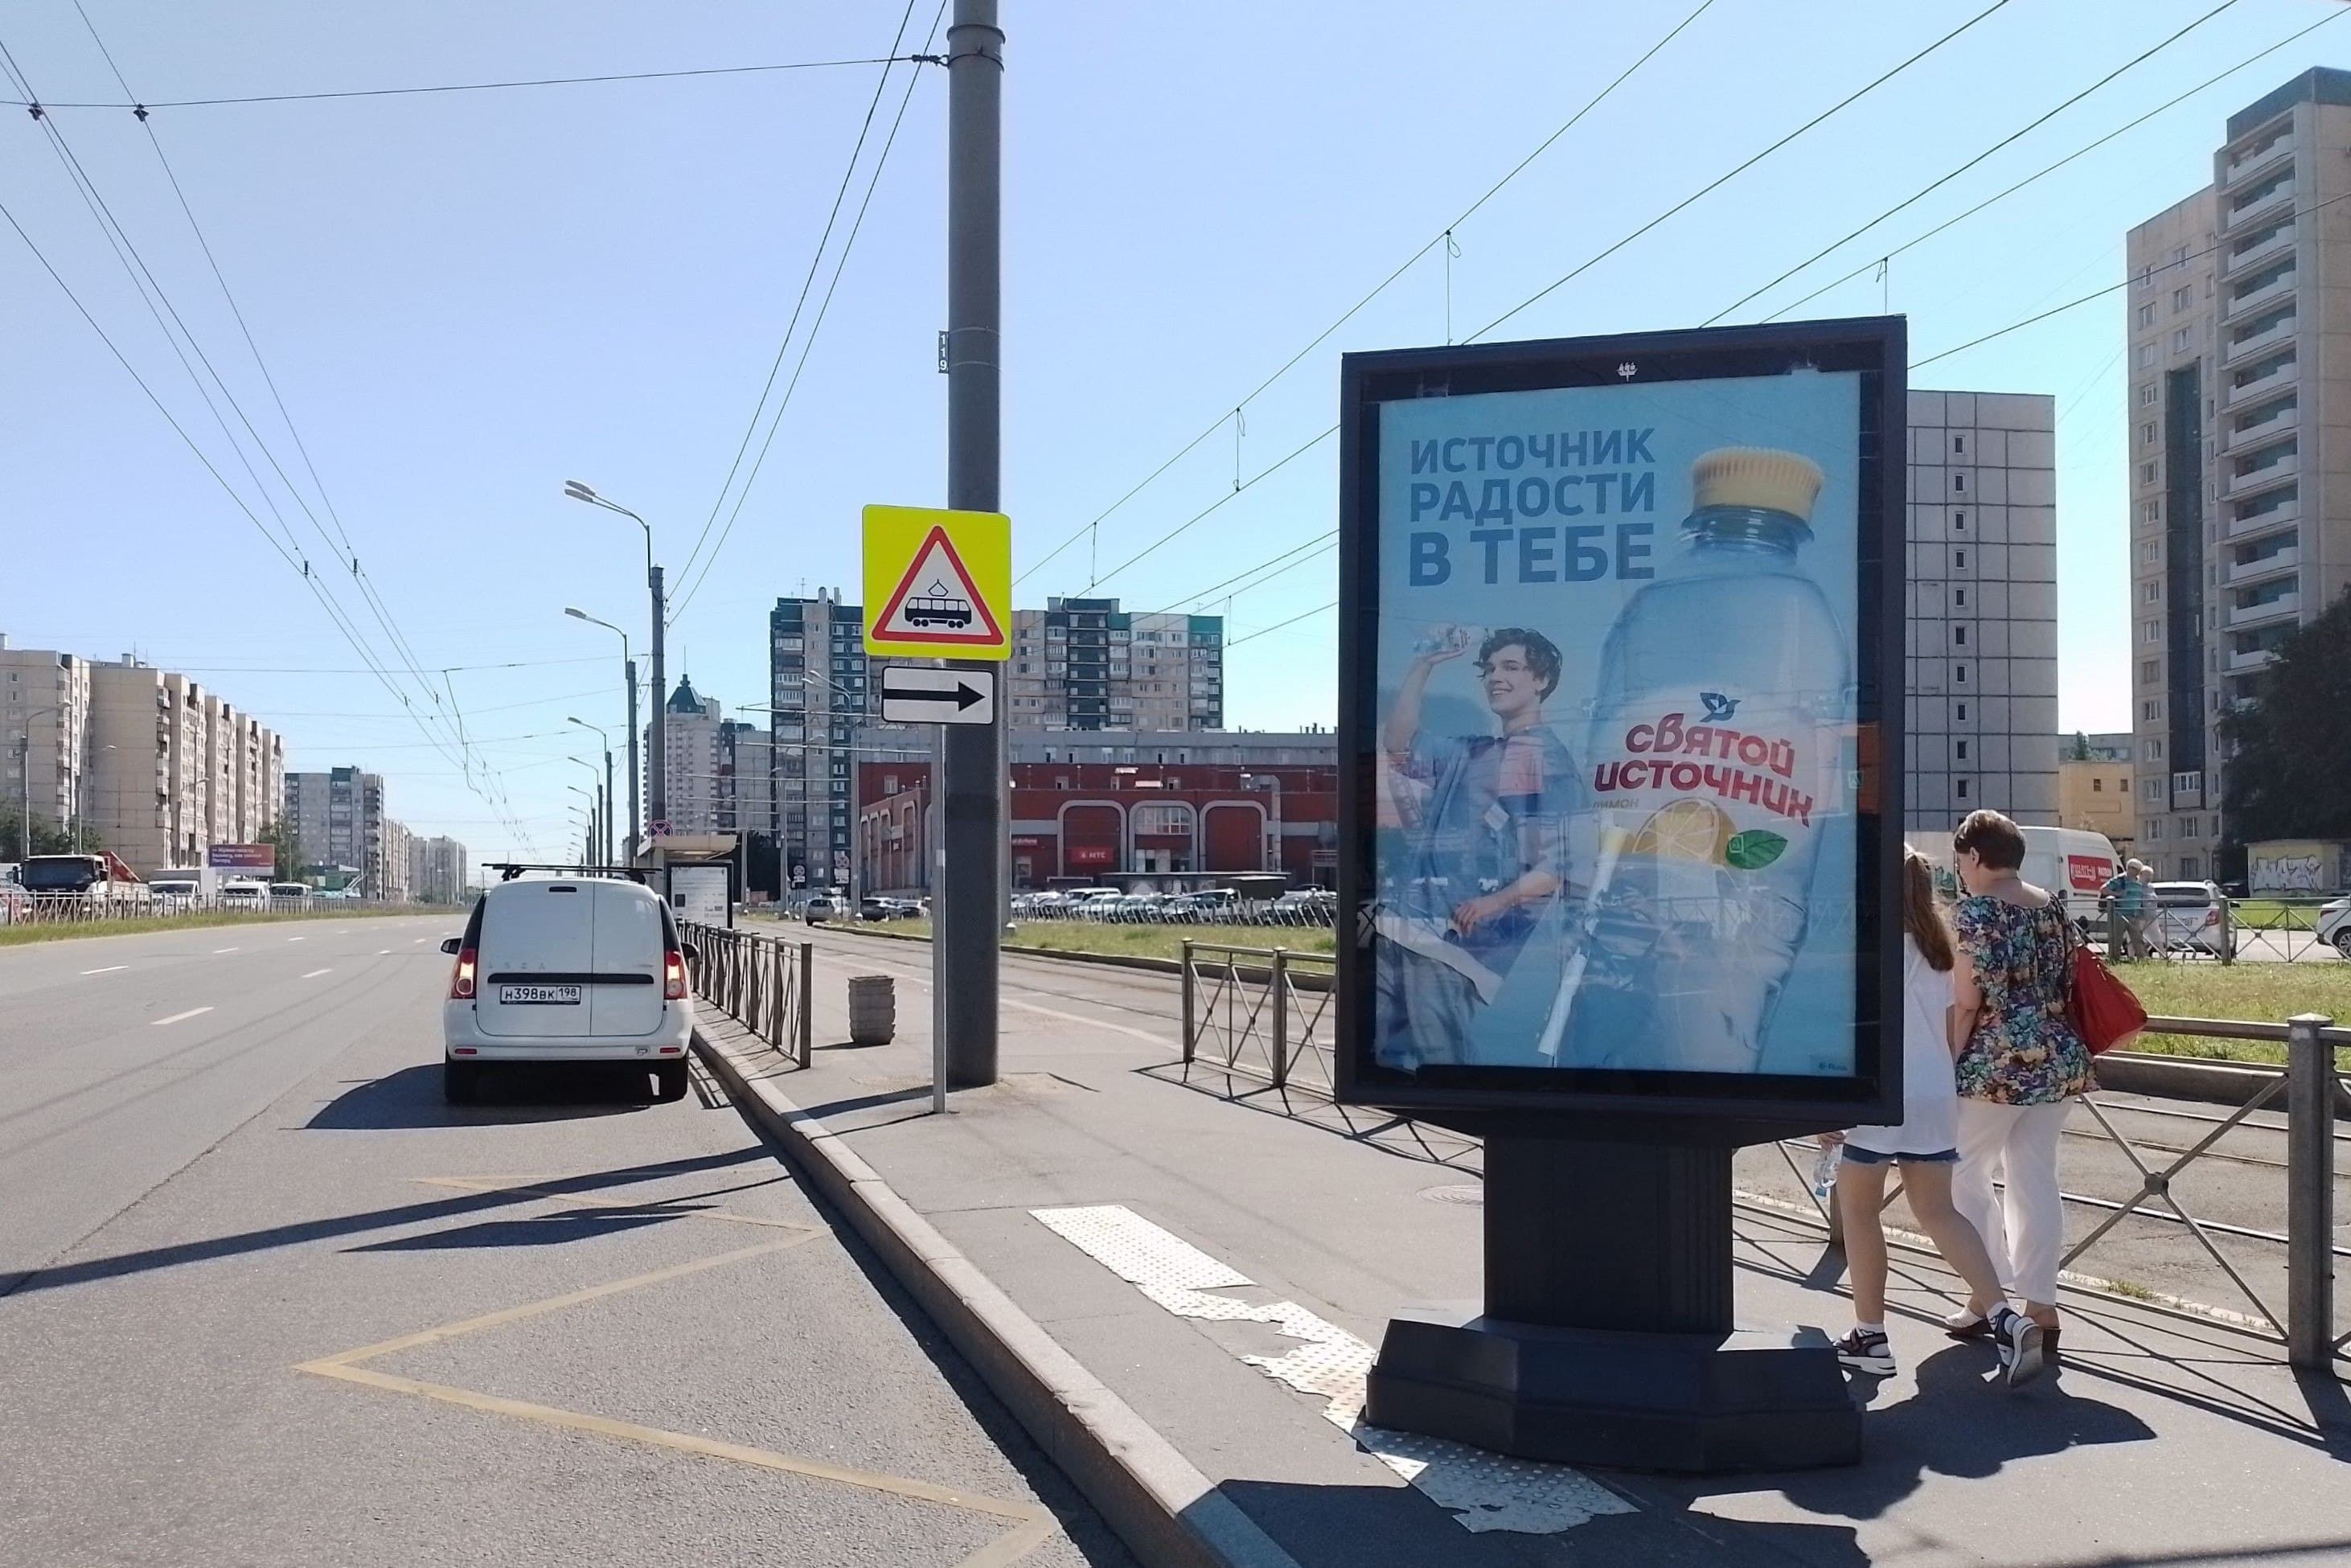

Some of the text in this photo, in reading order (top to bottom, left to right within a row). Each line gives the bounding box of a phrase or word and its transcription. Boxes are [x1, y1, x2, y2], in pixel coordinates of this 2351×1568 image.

[1411, 428, 1656, 475] ИСТОЧНИК
[1410, 471, 1655, 527] РАДОСТИ
[1409, 523, 1655, 587] В ТЕБЕ
[1625, 712, 1795, 779] СВЯТОЙ
[1594, 759, 1814, 827] ИСТОЧНИК
[558, 987, 577, 997] 198
